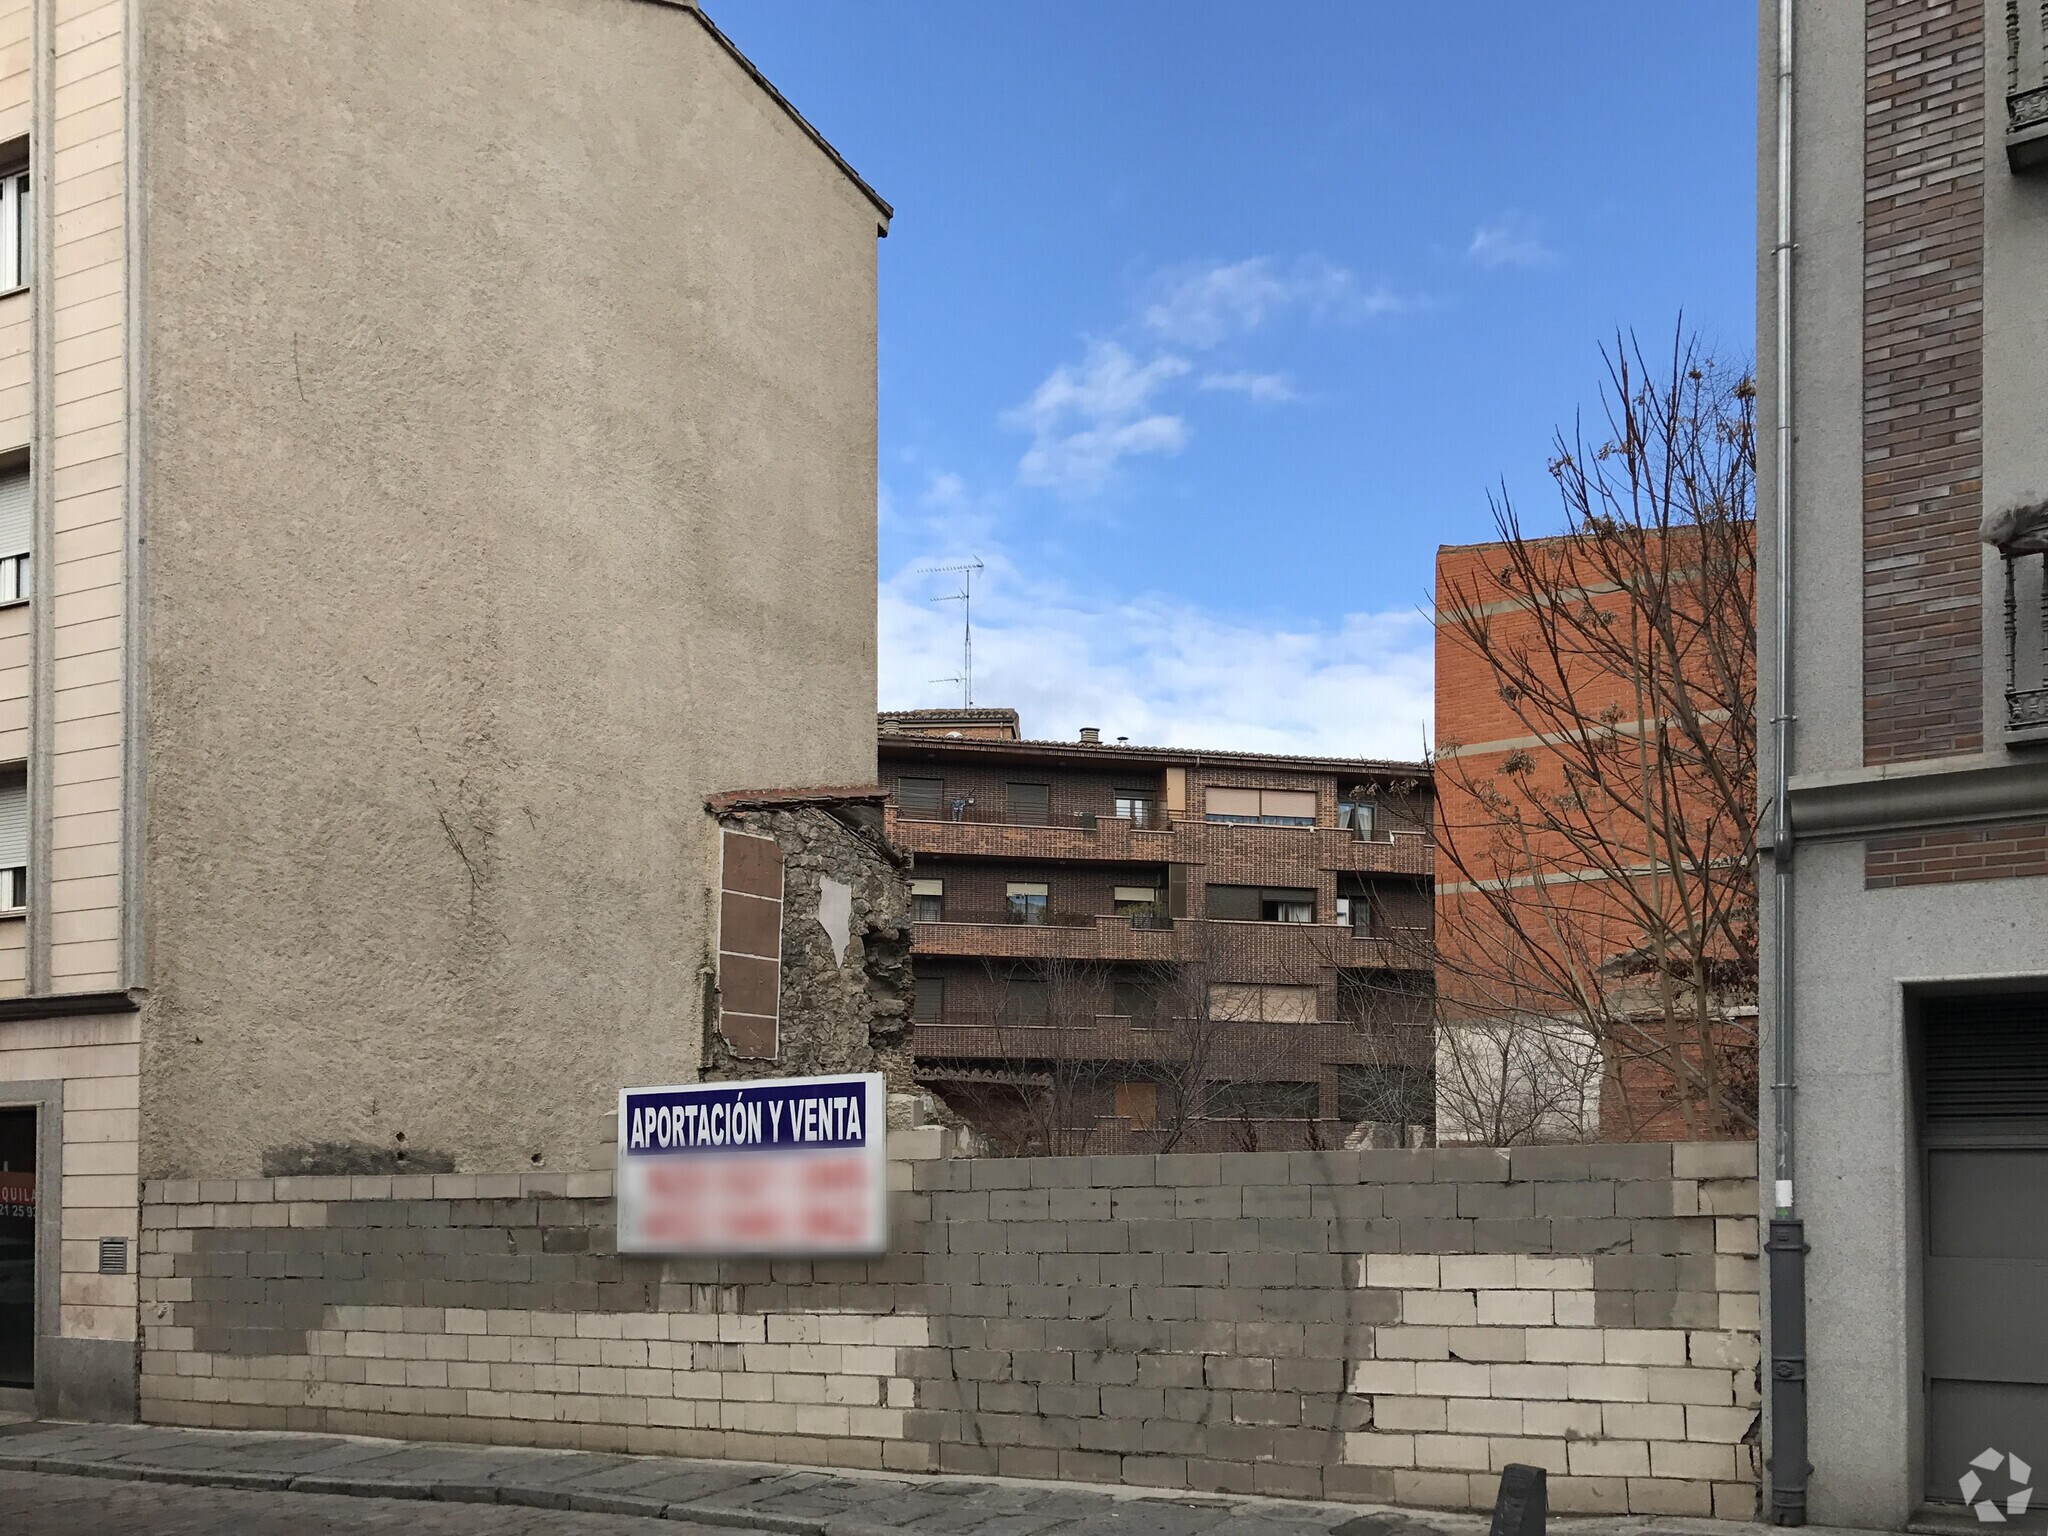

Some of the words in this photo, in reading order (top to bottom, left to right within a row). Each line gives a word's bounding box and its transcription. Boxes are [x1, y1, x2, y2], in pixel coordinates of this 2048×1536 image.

[630, 1092, 762, 1149] APORTACIÓN
[768, 1100, 784, 1143] Y
[789, 1096, 862, 1142] VENTA
[12, 1205, 24, 1217] 25
